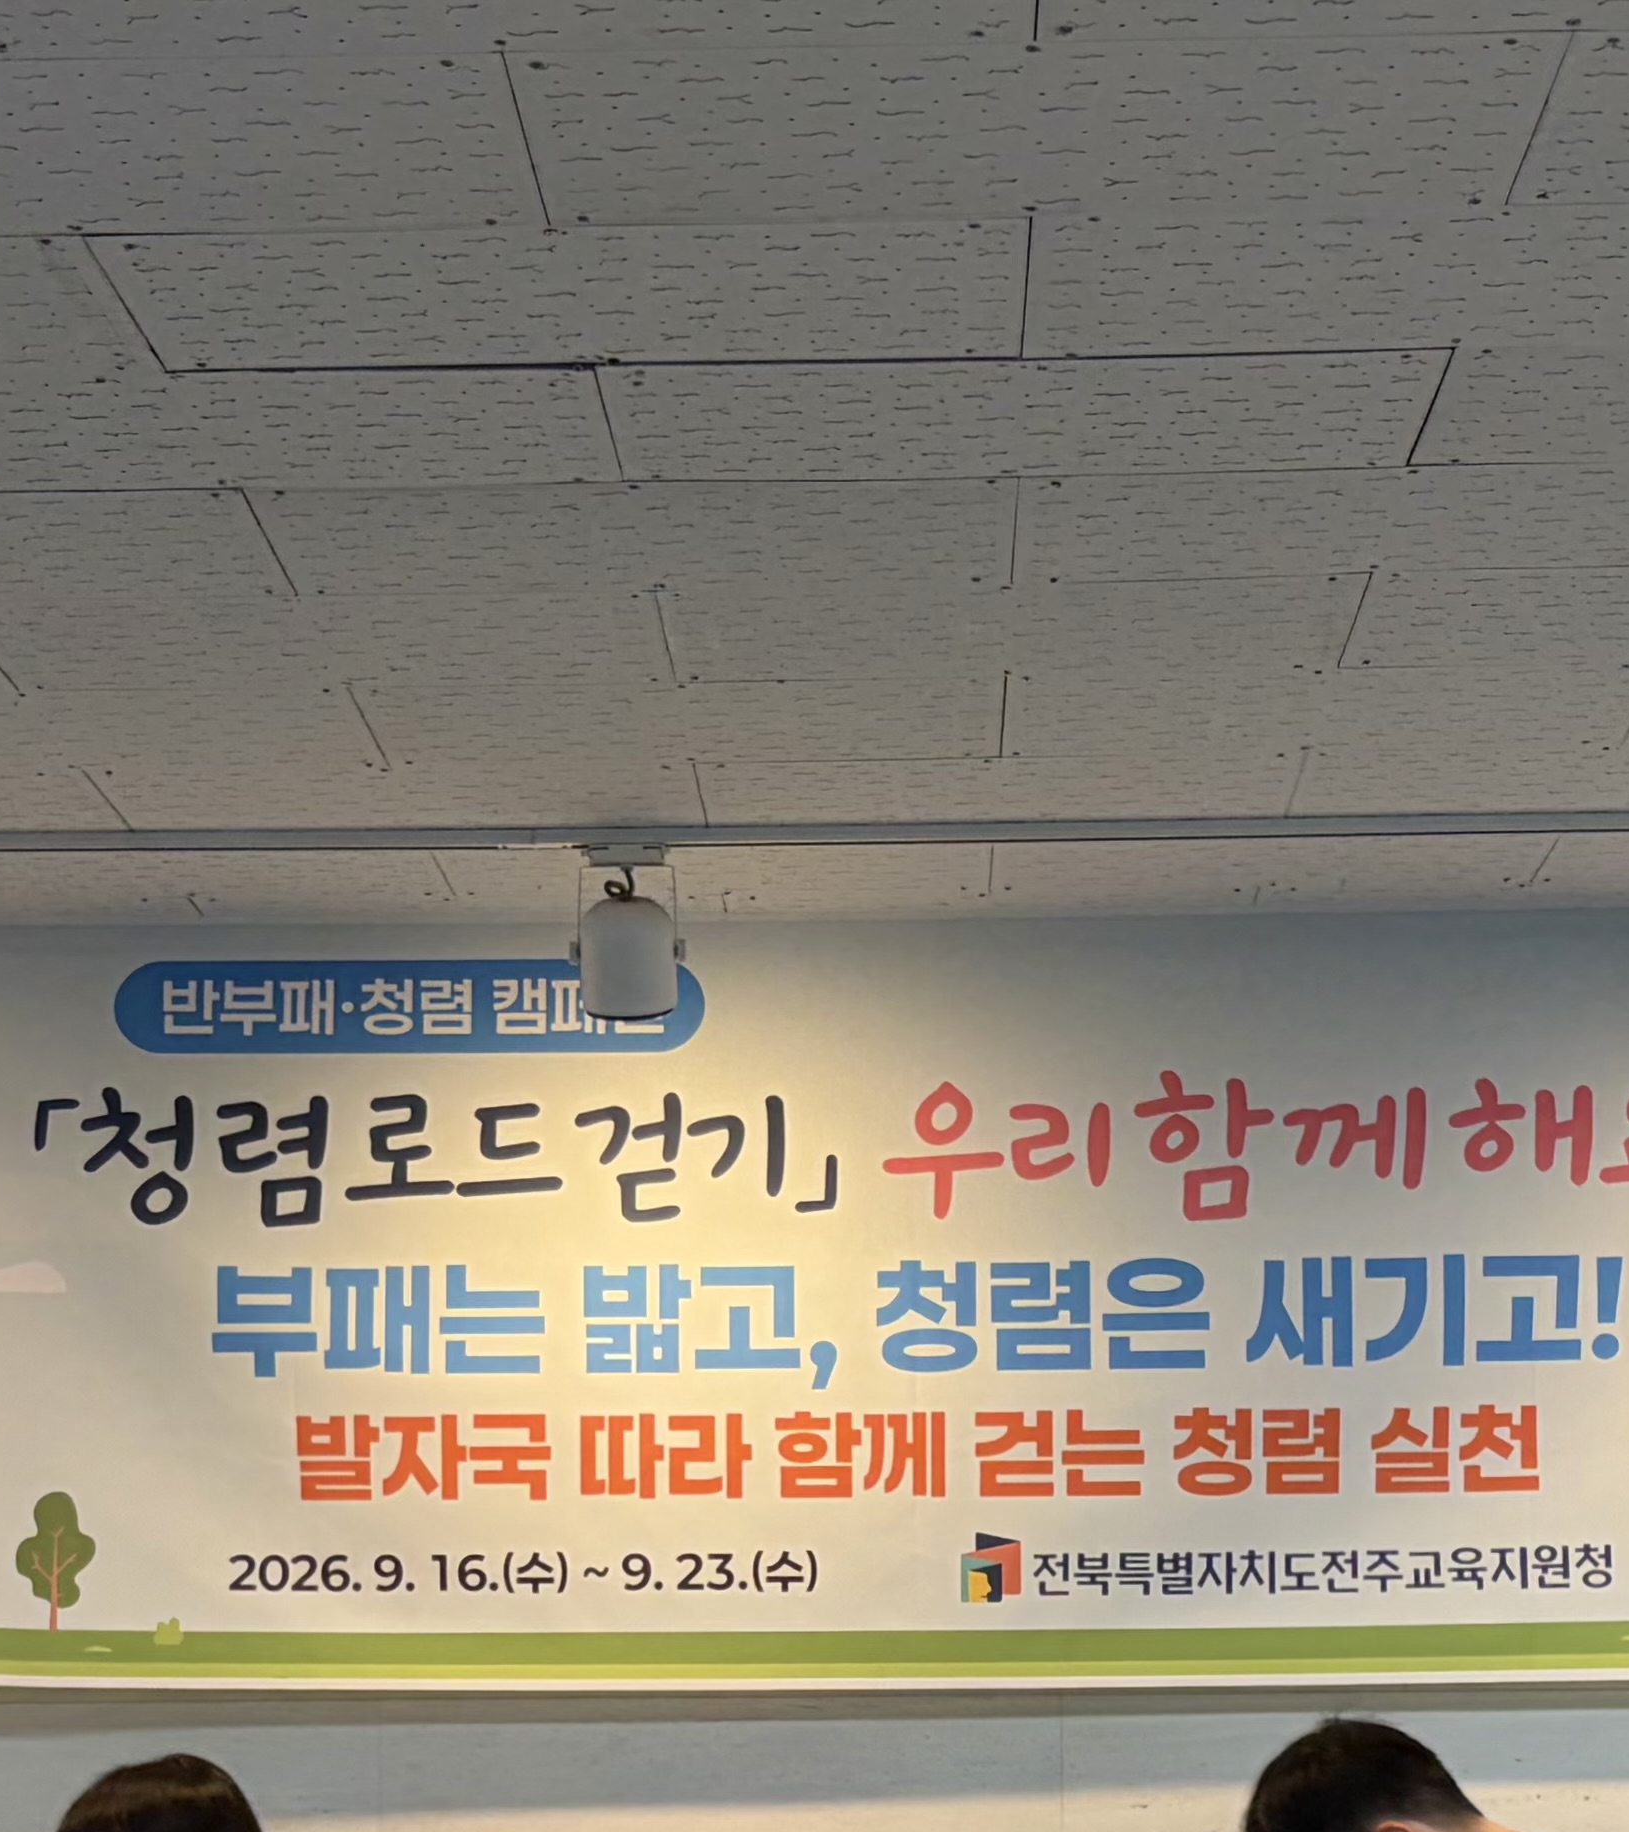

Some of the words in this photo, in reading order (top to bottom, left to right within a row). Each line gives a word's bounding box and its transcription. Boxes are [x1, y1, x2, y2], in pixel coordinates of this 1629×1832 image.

[164, 979, 472, 1035] 반부패·청렴
[491, 978, 665, 1034] 캠페
[211, 1265, 546, 1377] 부패는
[584, 1264, 837, 1389] 밟고,
[877, 1258, 1210, 1371] 청렴은
[1246, 1254, 1622, 1367] 새기고!
[296, 1414, 551, 1501] 발자국
[580, 1414, 752, 1499] 따라
[775, 1412, 945, 1498] 함께
[975, 1410, 1145, 1497] 걷는
[1174, 1407, 1340, 1496] 청렴
[1371, 1405, 1539, 1493] 실천
[1034, 1544, 1611, 1595] 전북특별자치도전주교육지원청
